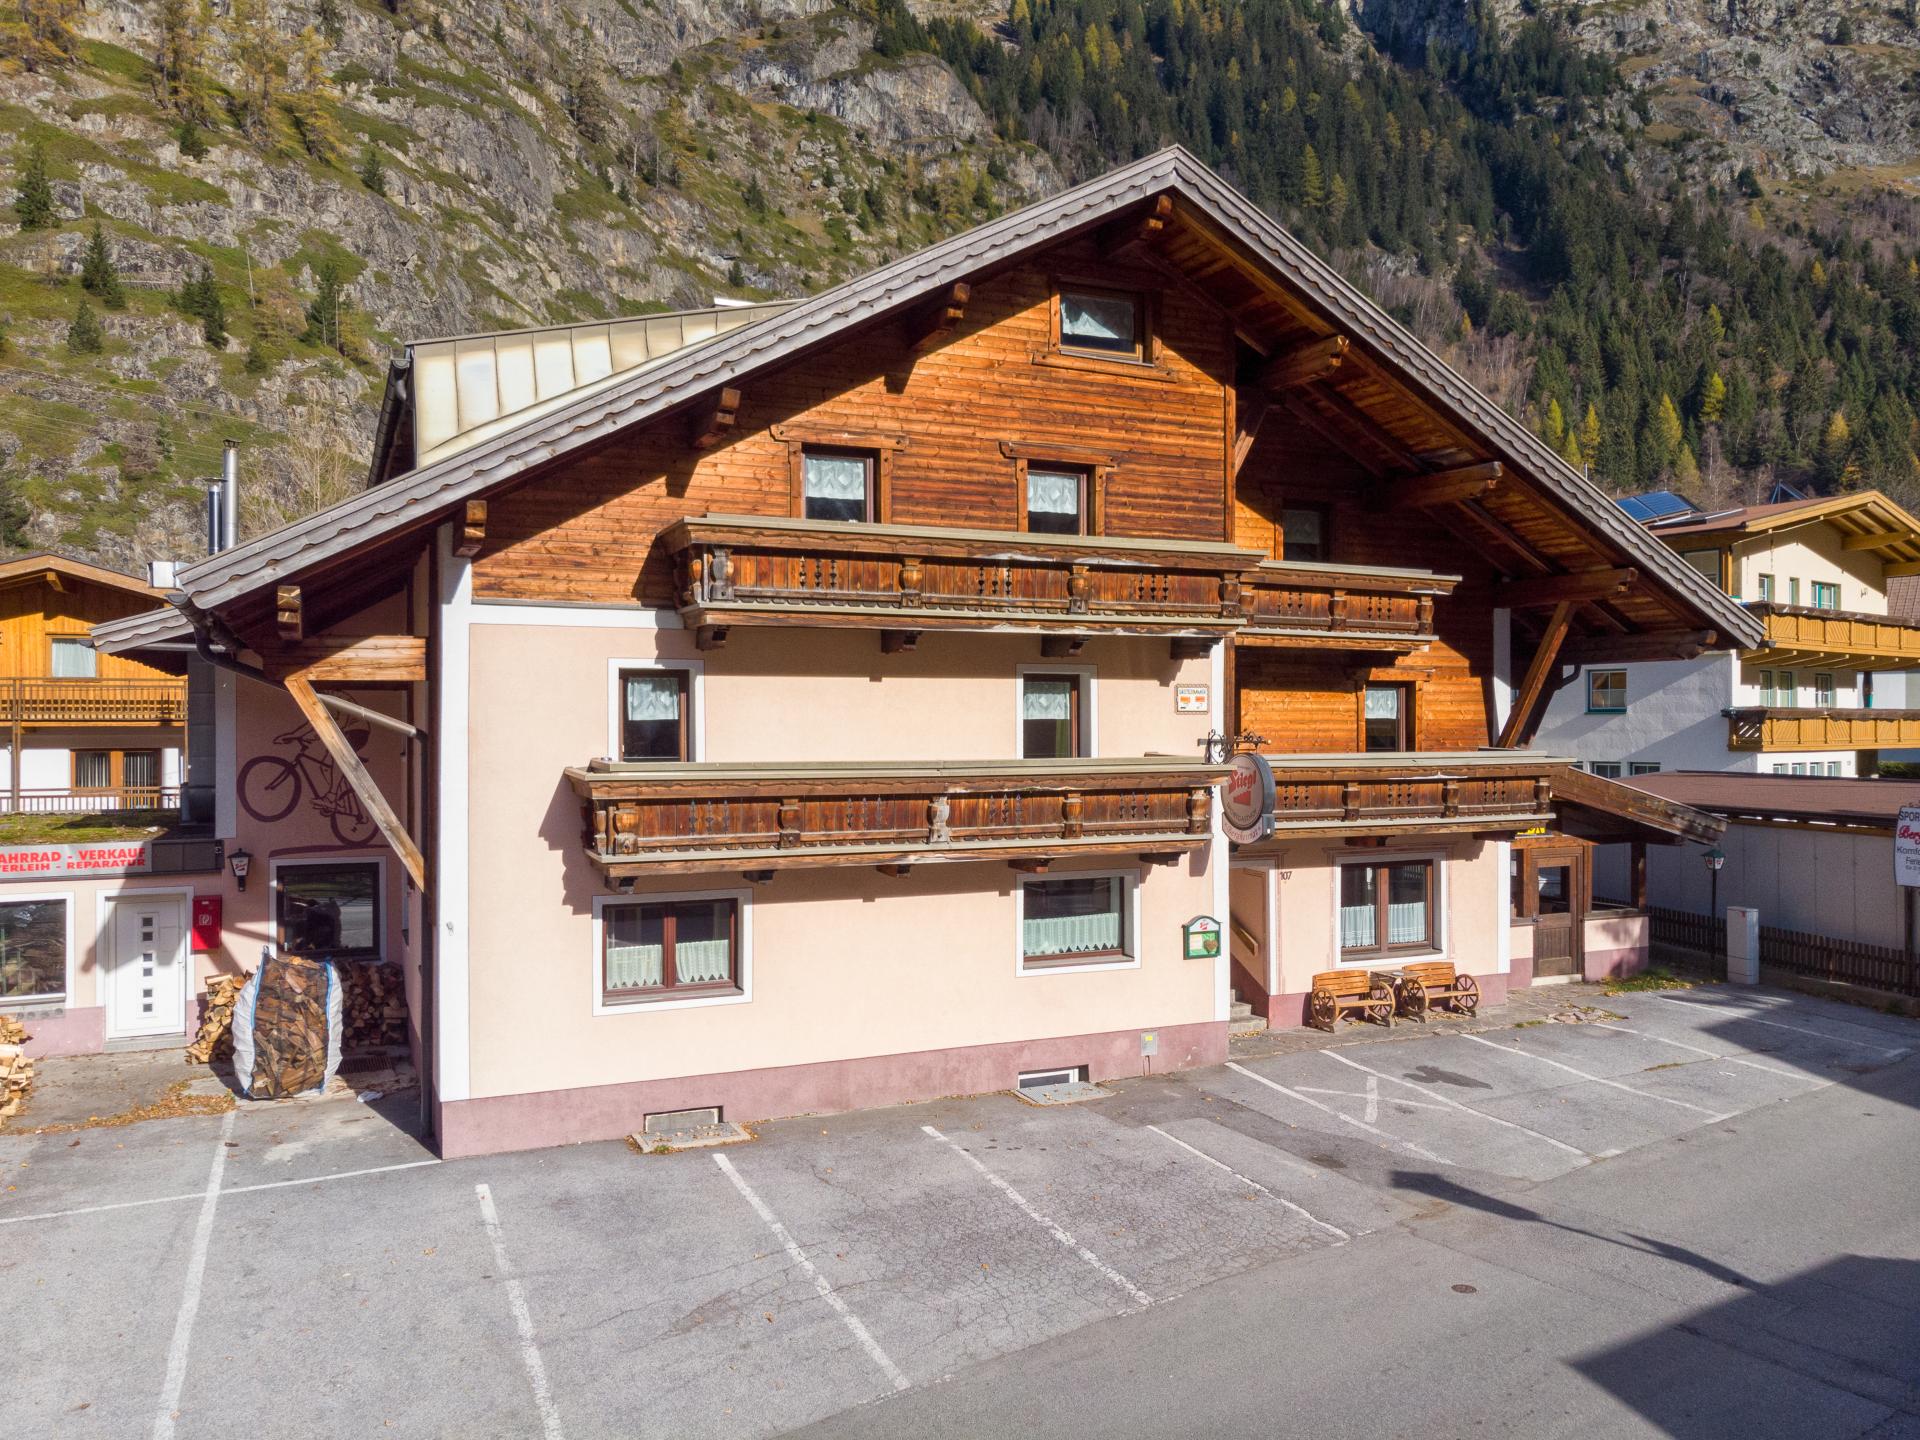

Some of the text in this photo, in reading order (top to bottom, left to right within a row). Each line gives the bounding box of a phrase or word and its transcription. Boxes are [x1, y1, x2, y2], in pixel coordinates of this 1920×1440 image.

[1229, 770, 1257, 796] Stiegl
[78, 848, 146, 861] VERKAUF
[0, 863, 50, 873] ERLEIH
[66, 859, 146, 870] REPARATUR
[1280, 871, 1293, 880] 107
